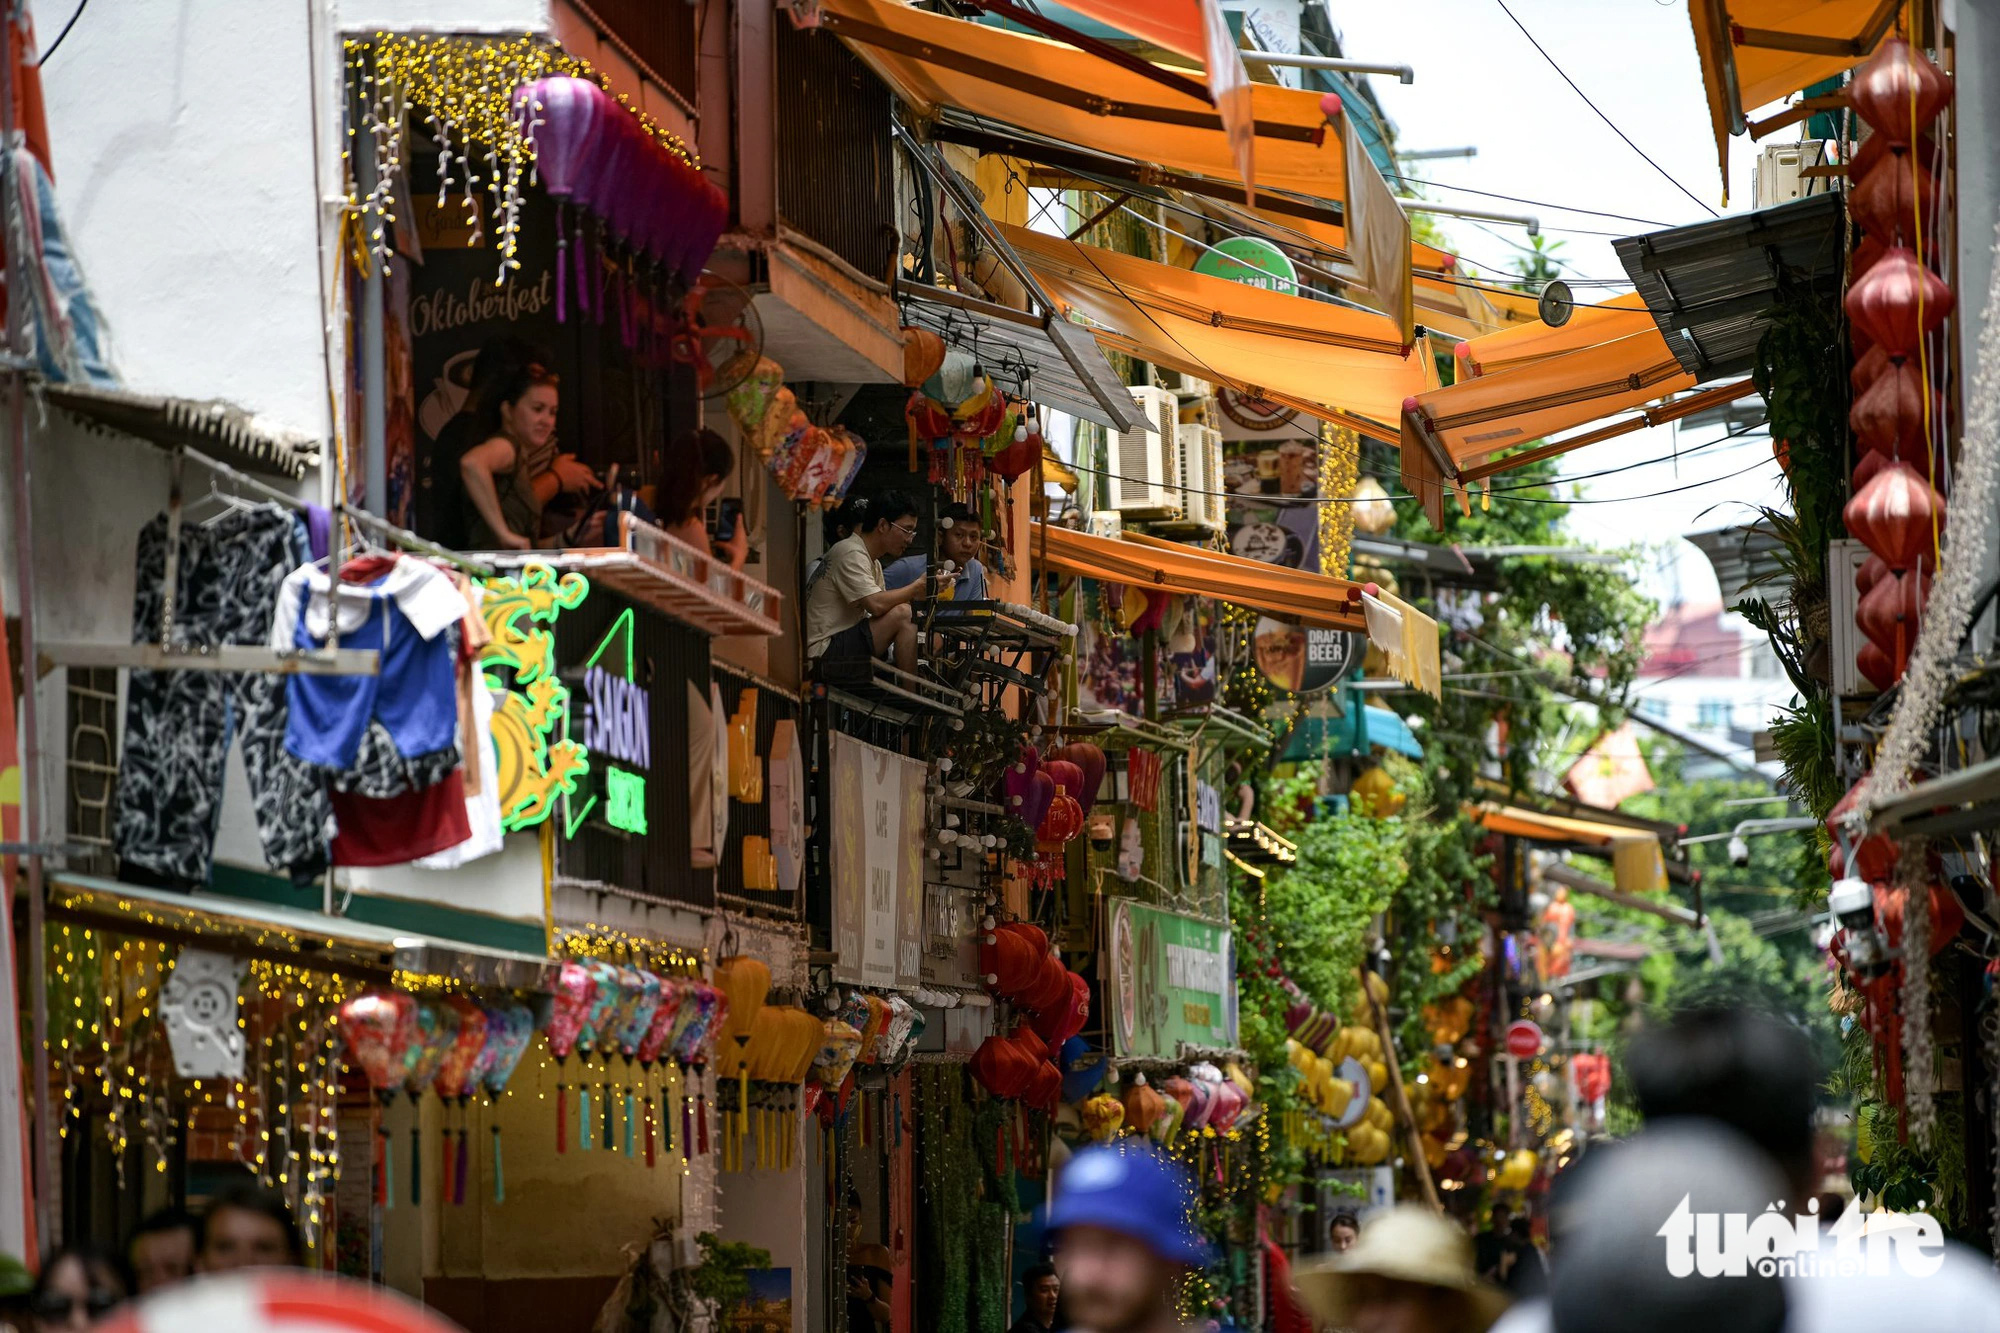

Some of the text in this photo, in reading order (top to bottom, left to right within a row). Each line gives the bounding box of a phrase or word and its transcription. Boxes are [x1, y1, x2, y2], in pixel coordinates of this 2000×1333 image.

[411, 269, 552, 337] Oktoberfest
[1309, 630, 1342, 644] DRAFT
[1309, 644, 1342, 661] BEER
[592, 665, 651, 771] SAIGON
[899, 938, 920, 978] SAIGON
